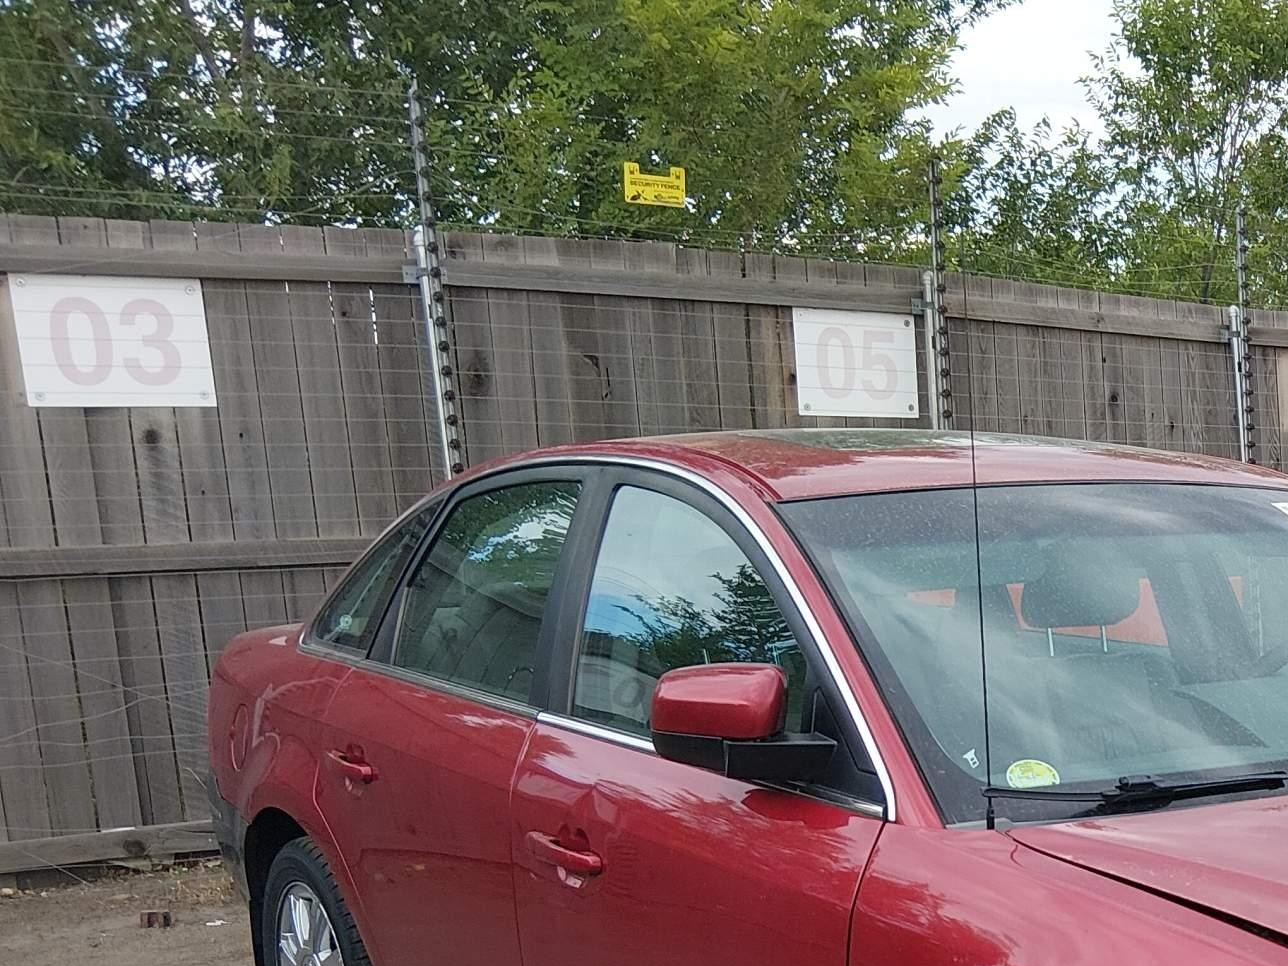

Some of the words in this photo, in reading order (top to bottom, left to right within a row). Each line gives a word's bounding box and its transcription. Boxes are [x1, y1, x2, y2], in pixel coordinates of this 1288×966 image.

[630, 180, 660, 189] SECURITY
[660, 183, 681, 191] FENCE
[50, 296, 183, 386] 03
[816, 326, 898, 400] 05
